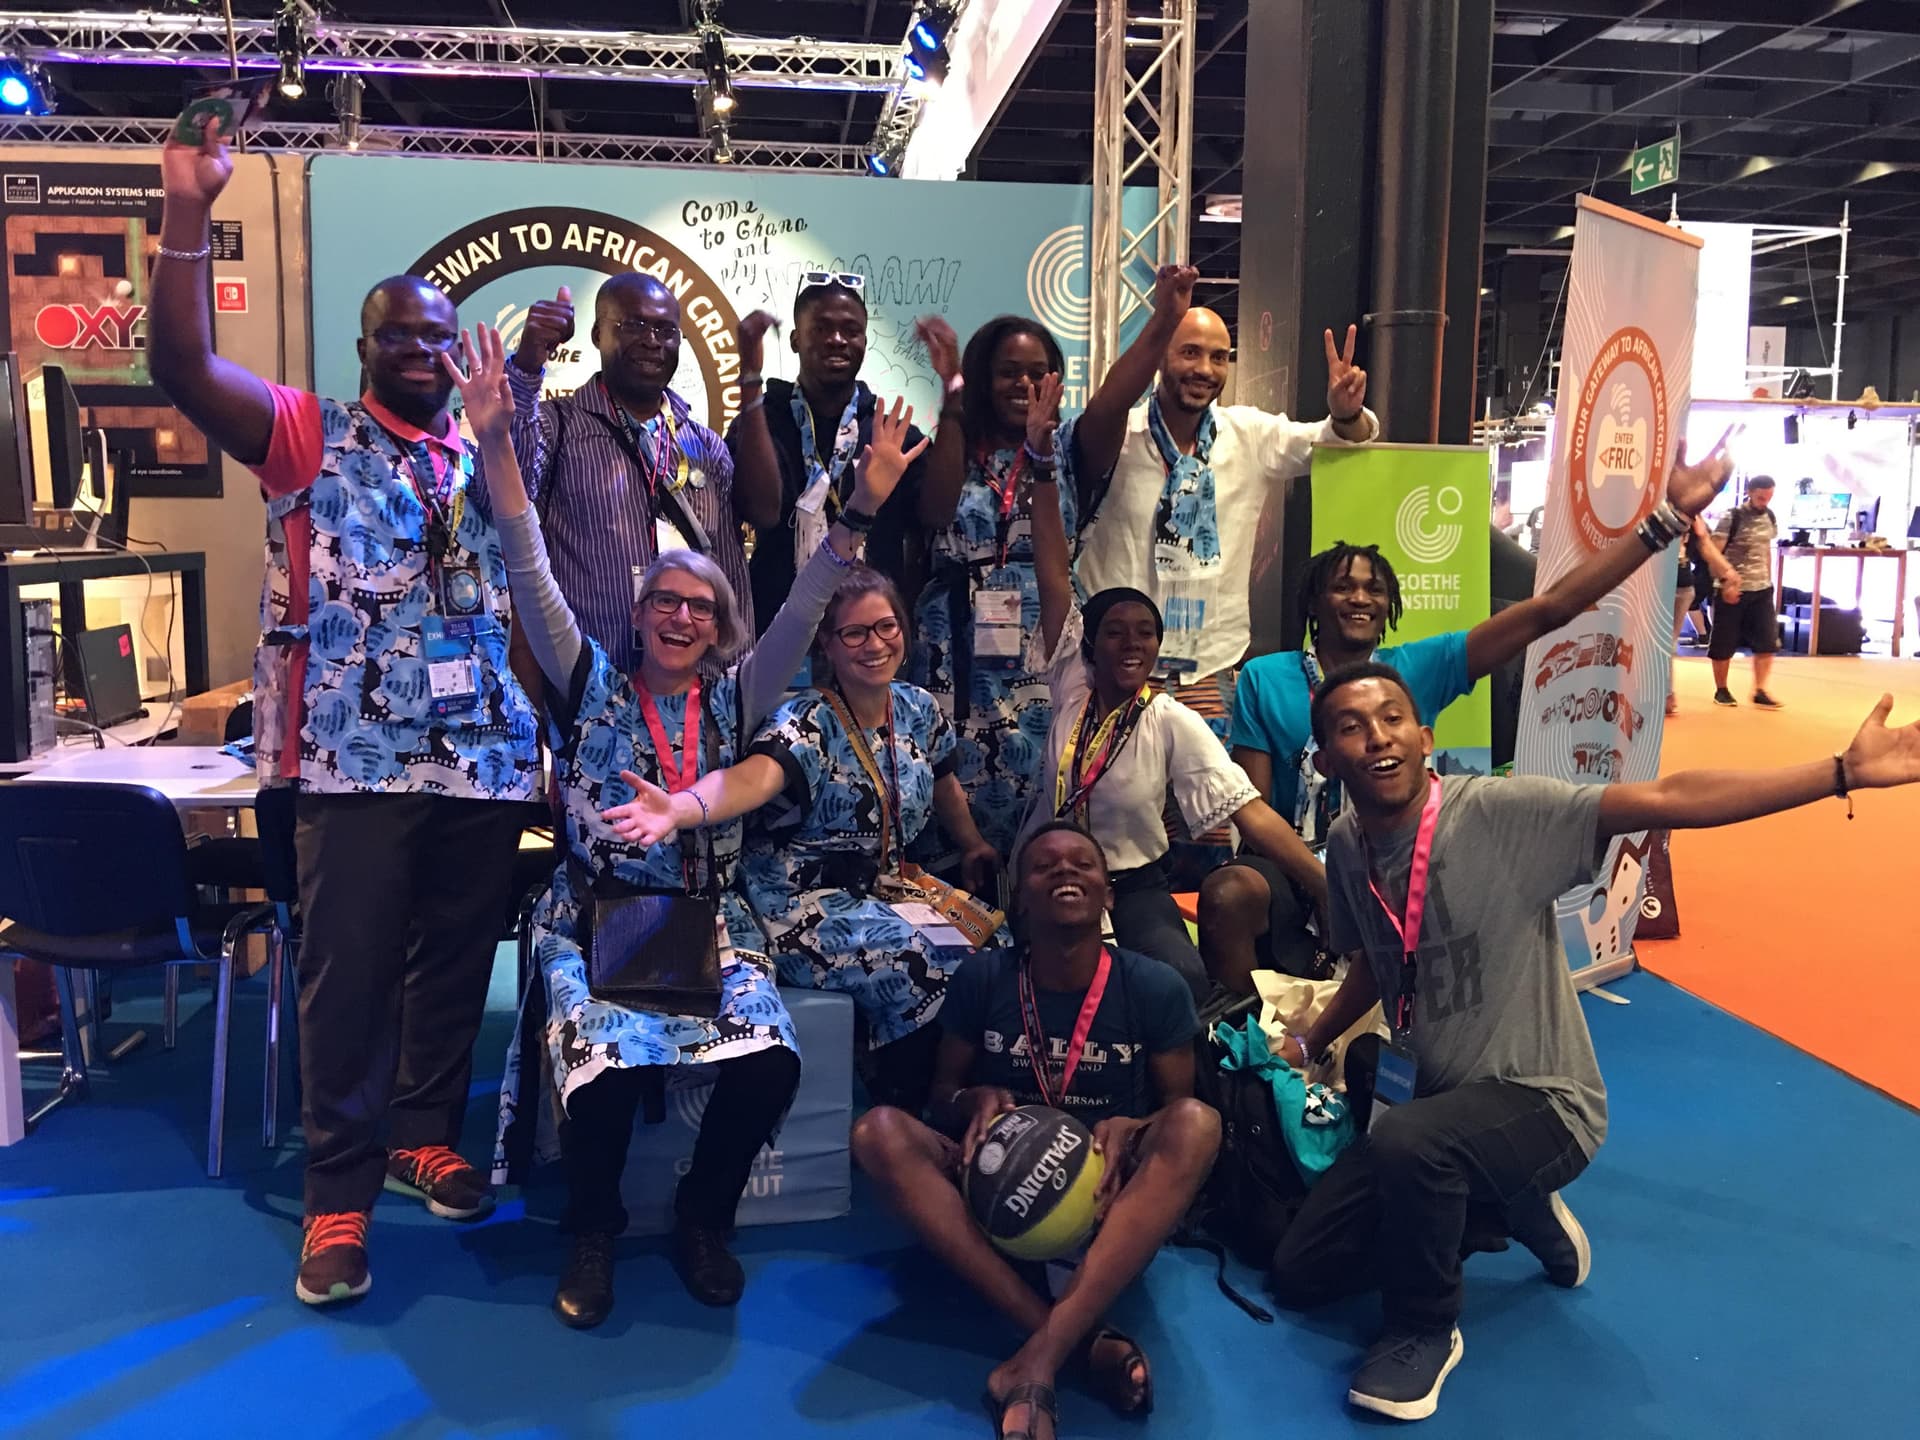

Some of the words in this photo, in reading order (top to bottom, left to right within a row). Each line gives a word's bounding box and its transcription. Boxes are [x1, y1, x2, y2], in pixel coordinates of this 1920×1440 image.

[47, 186, 103, 196] APPLICATION
[105, 187, 143, 197] SYSTEMS
[682, 199, 758, 227] Come
[700, 228, 725, 250] to
[736, 216, 808, 240] Ghana
[424, 231, 503, 294] EWAY
[509, 223, 553, 253] TO
[561, 223, 694, 299] AFRICAN
[734, 237, 770, 258] and
[34, 303, 147, 350] OXY
[548, 347, 582, 363] ORE
[1574, 407, 1590, 460] YOUR
[1585, 340, 1620, 405] GATEWAY
[1621, 335, 1632, 353] TO
[1633, 337, 1660, 383] AFRICAN
[1654, 382, 1665, 468] CREATORS
[1614, 432, 1634, 445] ENTER
[1397, 573, 1461, 591] GOETHE
[1401, 594, 1461, 611] NSTITUT
[984, 1029, 1142, 1065] BALLY
[1004, 1123, 1082, 1218] SPALDING
